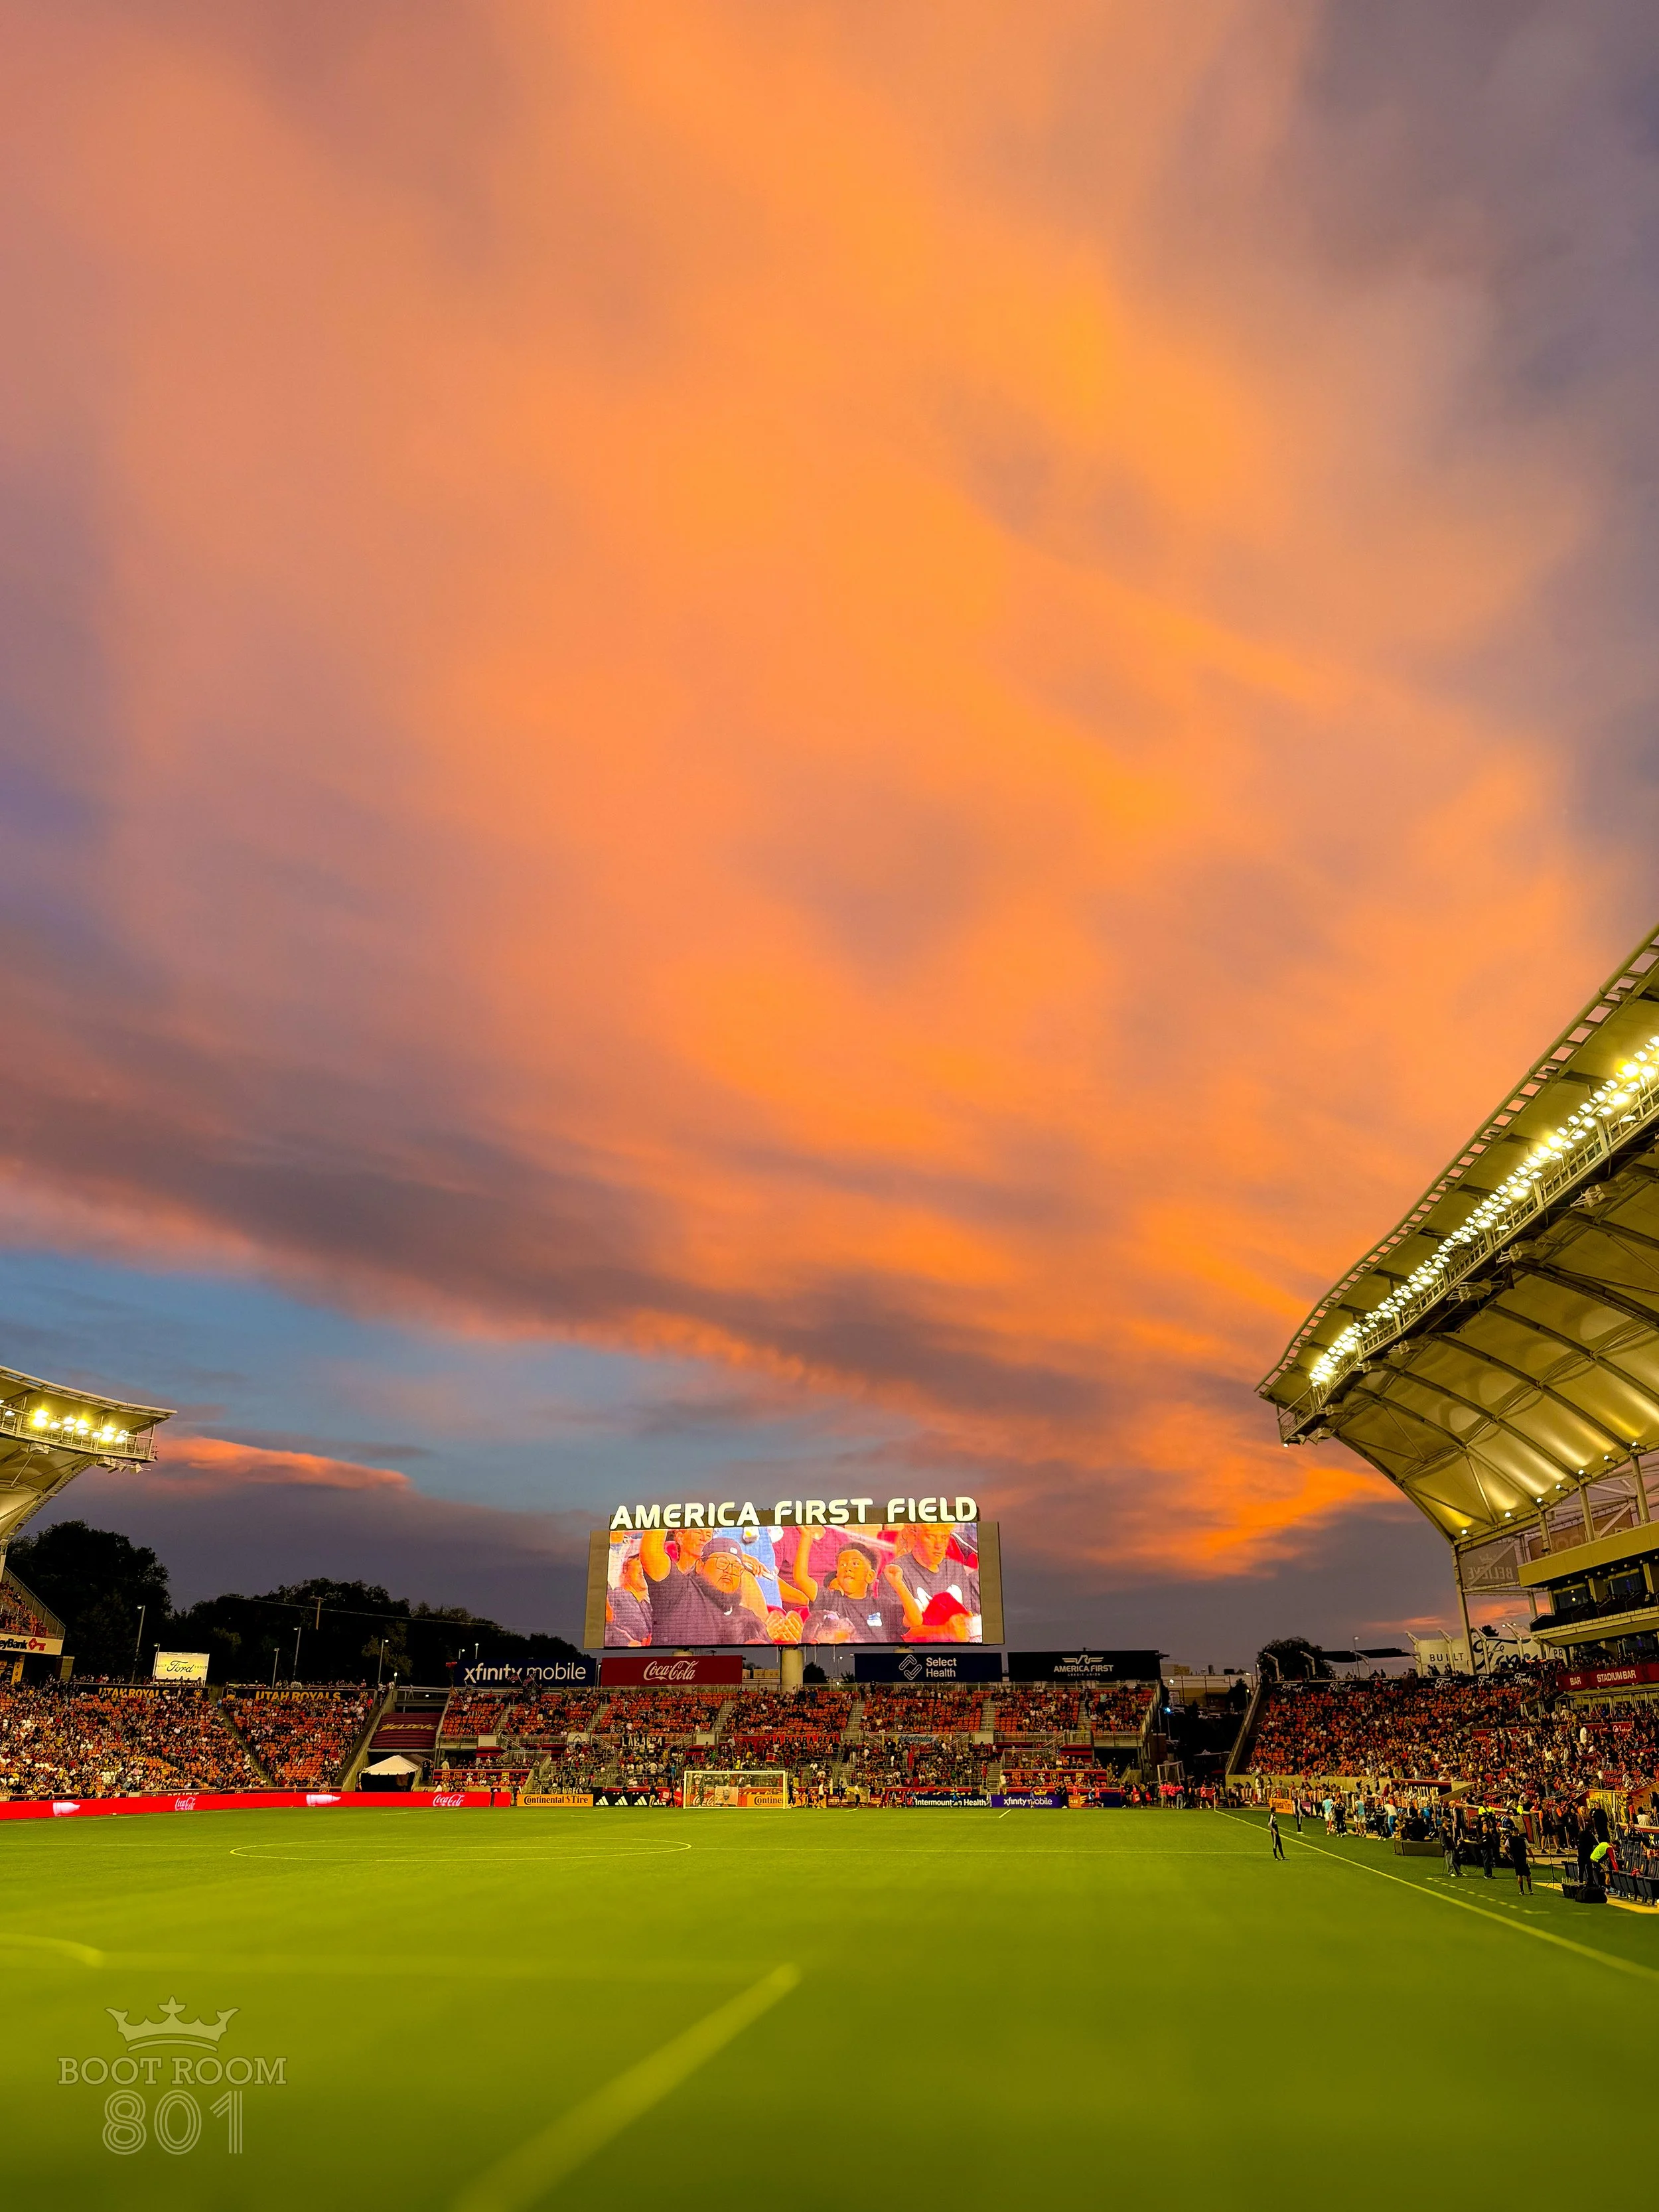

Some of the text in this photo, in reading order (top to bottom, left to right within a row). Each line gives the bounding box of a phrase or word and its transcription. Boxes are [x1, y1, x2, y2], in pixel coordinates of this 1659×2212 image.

[610, 1496, 978, 1530] AMERICA FIRST FIELD
[0, 1638, 27, 1650] eyBank
[926, 1657, 957, 1666] Select
[1429, 1653, 1464, 1662] BUILT
[167, 1660, 195, 1672] Ford
[643, 1660, 699, 1680] Coca-Cola
[464, 1662, 586, 1684] xfinity mobile
[926, 1668, 956, 1678] Health
[1597, 1670, 1636, 1683] STADIUM BAR
[1569, 1676, 1581, 1686] BAR
[1281, 1683, 1303, 1693] Fd
[255, 1691, 341, 1702] UTAH ROYALS
[524, 1795, 588, 1805] Continental Tire
[755, 1796, 783, 1805] Contine
[1003, 1797, 1027, 1806] xfinity
